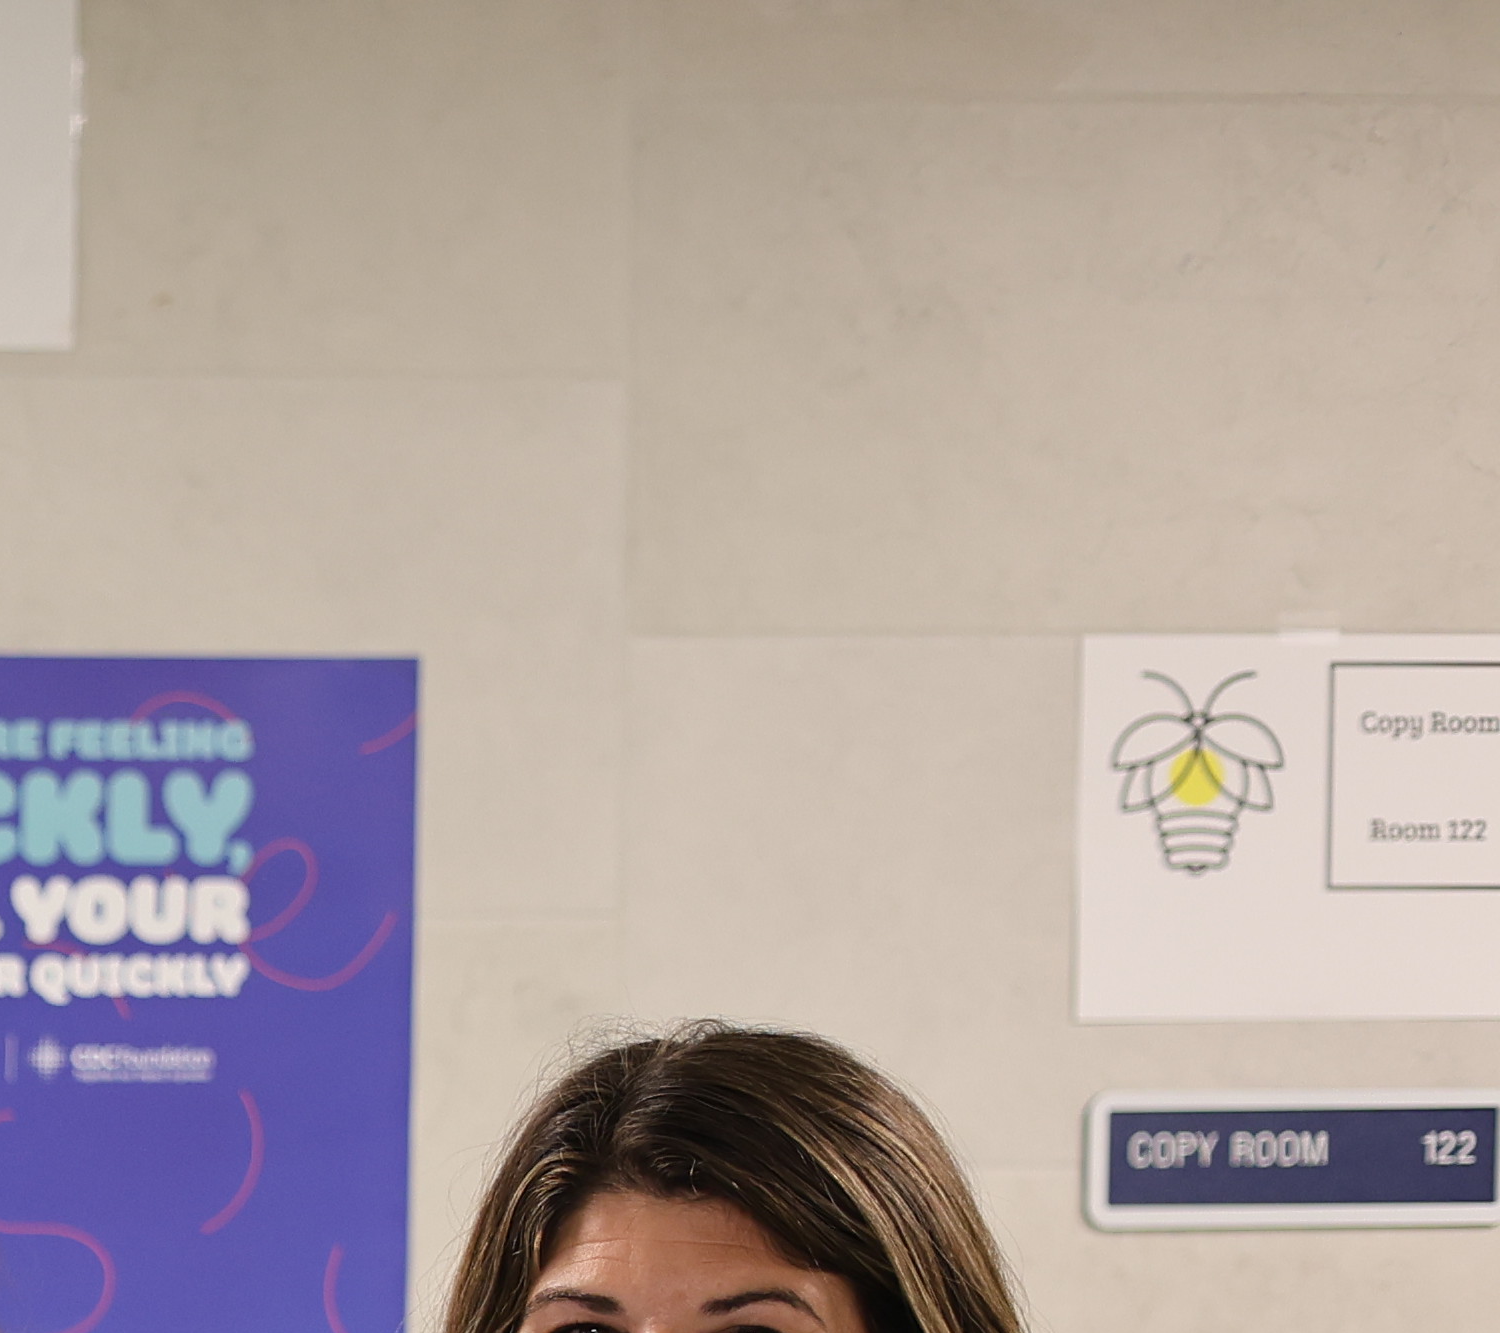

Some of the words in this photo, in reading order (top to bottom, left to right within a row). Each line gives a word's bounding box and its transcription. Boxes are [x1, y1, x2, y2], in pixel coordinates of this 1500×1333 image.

[47, 717, 254, 761] FEELING
[1361, 710, 1424, 740] Copy
[1431, 710, 1500, 733] Room
[1370, 817, 1440, 841] Room
[1447, 818, 1488, 841] 122
[10, 874, 251, 945] YOUR
[29, 952, 251, 1006] QUICKLY
[1126, 1130, 1220, 1167] COPY
[1228, 1130, 1328, 1166] ROOM
[1420, 1129, 1477, 1165] 122
